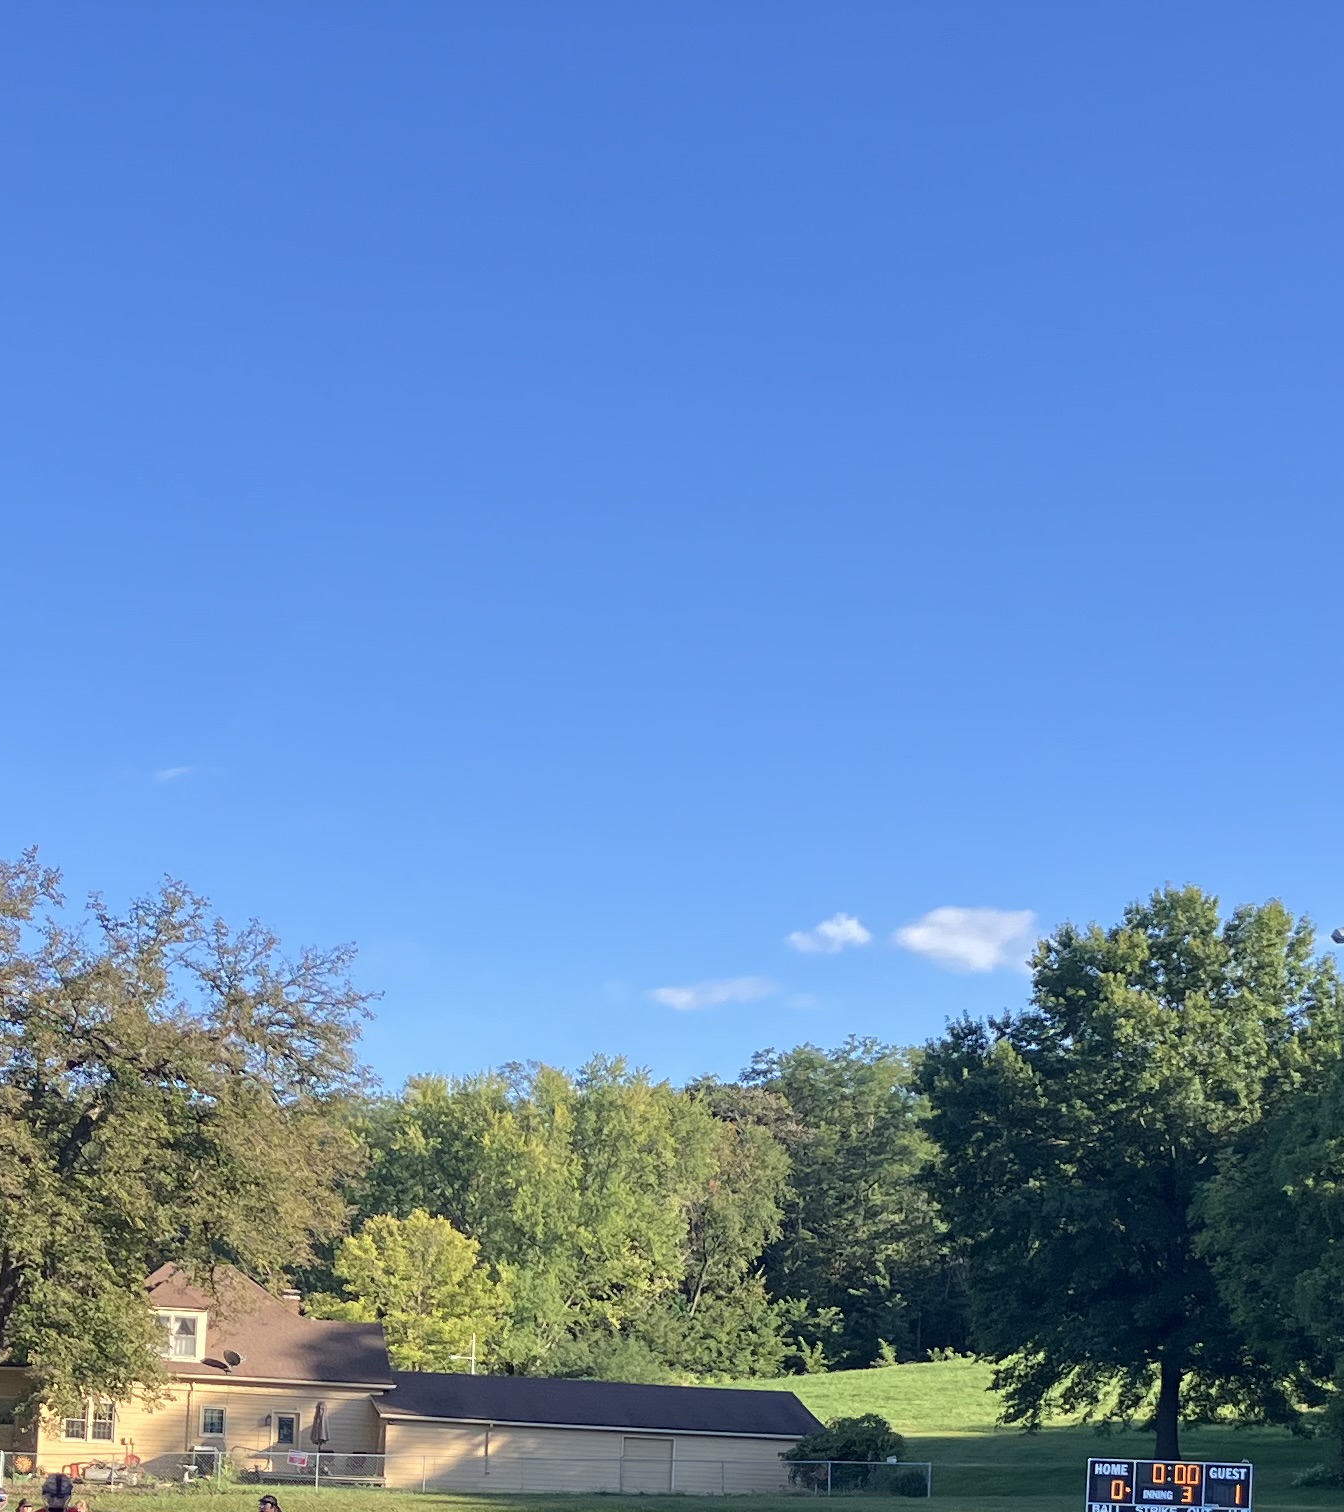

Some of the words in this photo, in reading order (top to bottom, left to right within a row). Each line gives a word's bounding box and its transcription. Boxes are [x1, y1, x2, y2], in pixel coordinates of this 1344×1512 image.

[1094, 1463, 1129, 1476] HOME
[1152, 1463, 1200, 1485] 0:00
[1209, 1467, 1247, 1481] GUEST
[1111, 1479, 1124, 1500] 0
[1142, 1489, 1174, 1500] INNING
[1181, 1486, 1193, 1503] 3
[1235, 1484, 1241, 1505] 1
